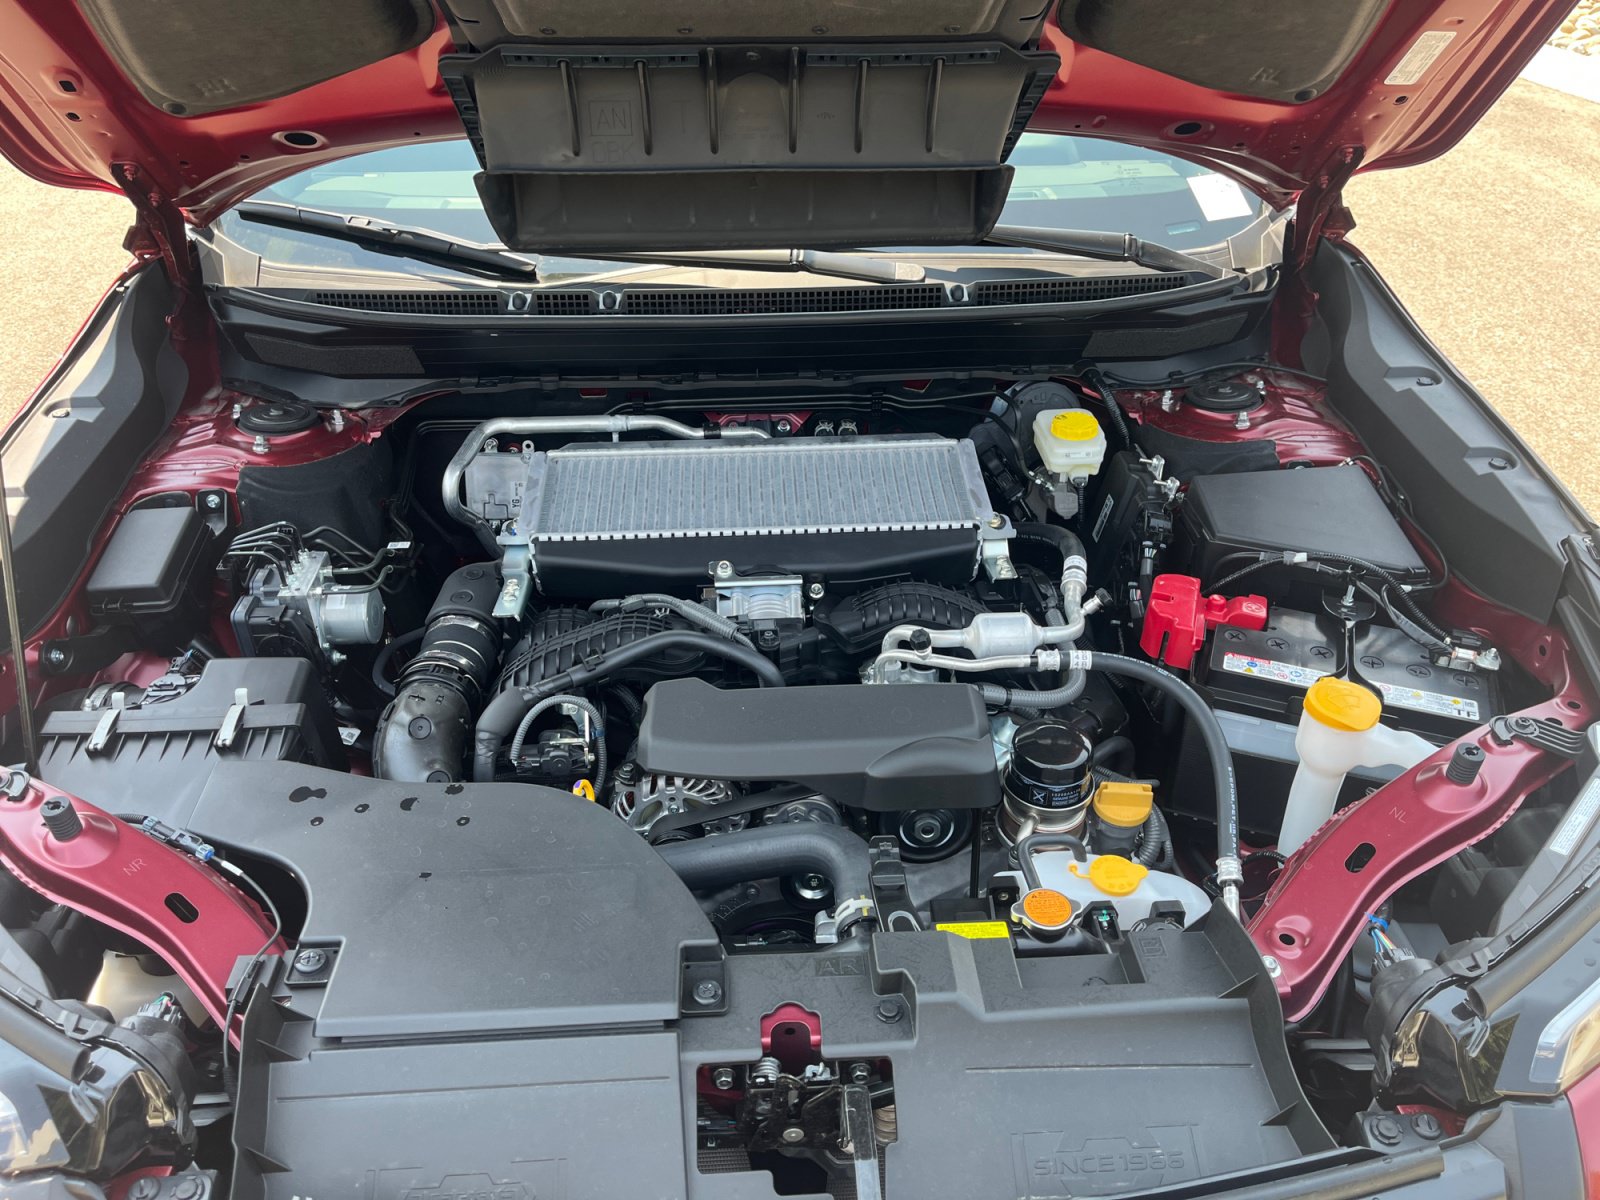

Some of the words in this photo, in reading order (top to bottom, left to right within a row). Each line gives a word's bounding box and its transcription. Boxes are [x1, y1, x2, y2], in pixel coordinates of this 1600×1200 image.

[597, 106, 627, 130] AN
[1389, 806, 1406, 824] NL
[123, 858, 147, 876] NR
[1033, 1155, 1116, 1176] SINCE
[1118, 1151, 1186, 1173] 1966
